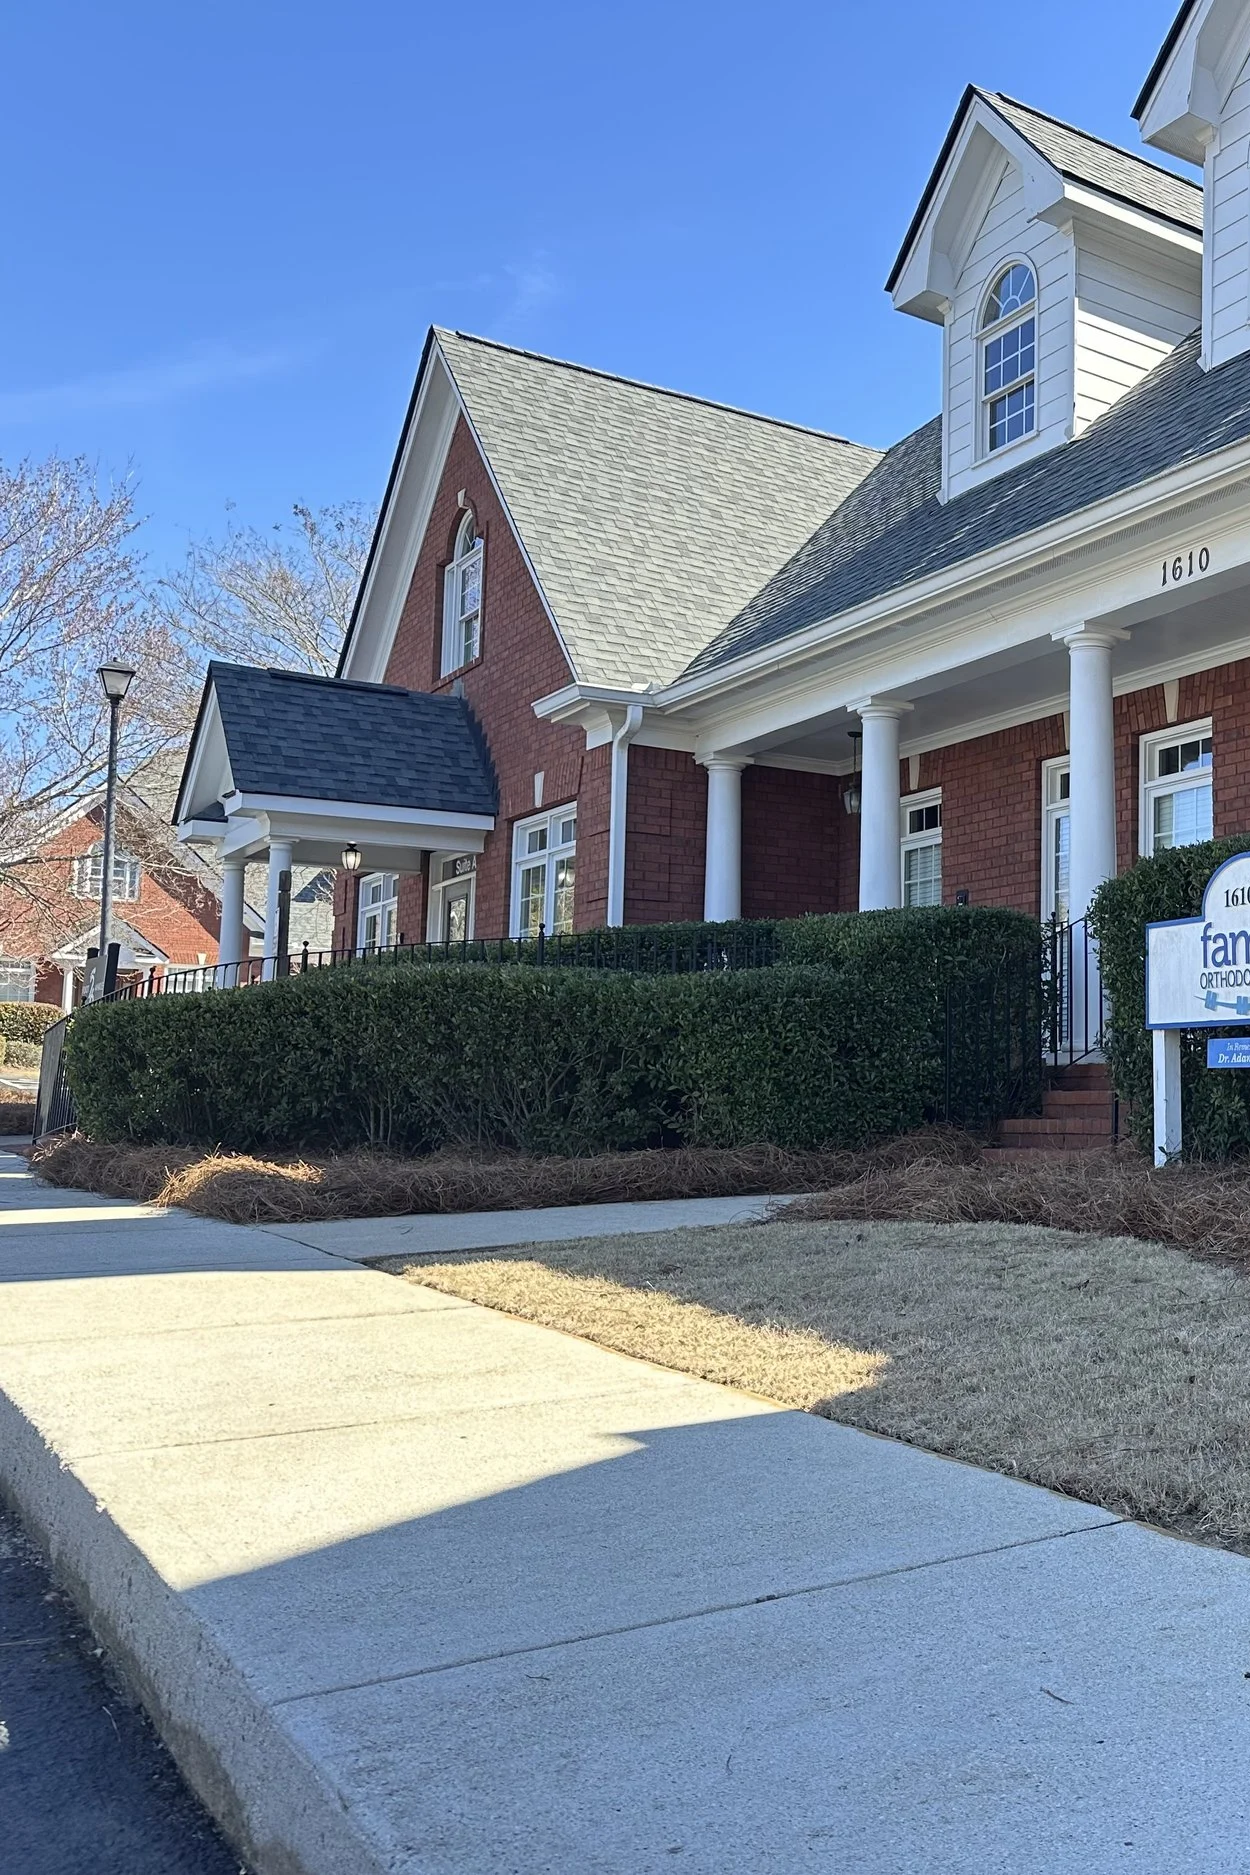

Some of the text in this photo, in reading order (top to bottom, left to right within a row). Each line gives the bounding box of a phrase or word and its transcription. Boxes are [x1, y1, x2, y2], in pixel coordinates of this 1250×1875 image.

[1162, 547, 1210, 587] 1610
[471, 855, 477, 870] A
[1226, 1042, 1234, 1051] In
[1217, 1053, 1230, 1064] Dr.
